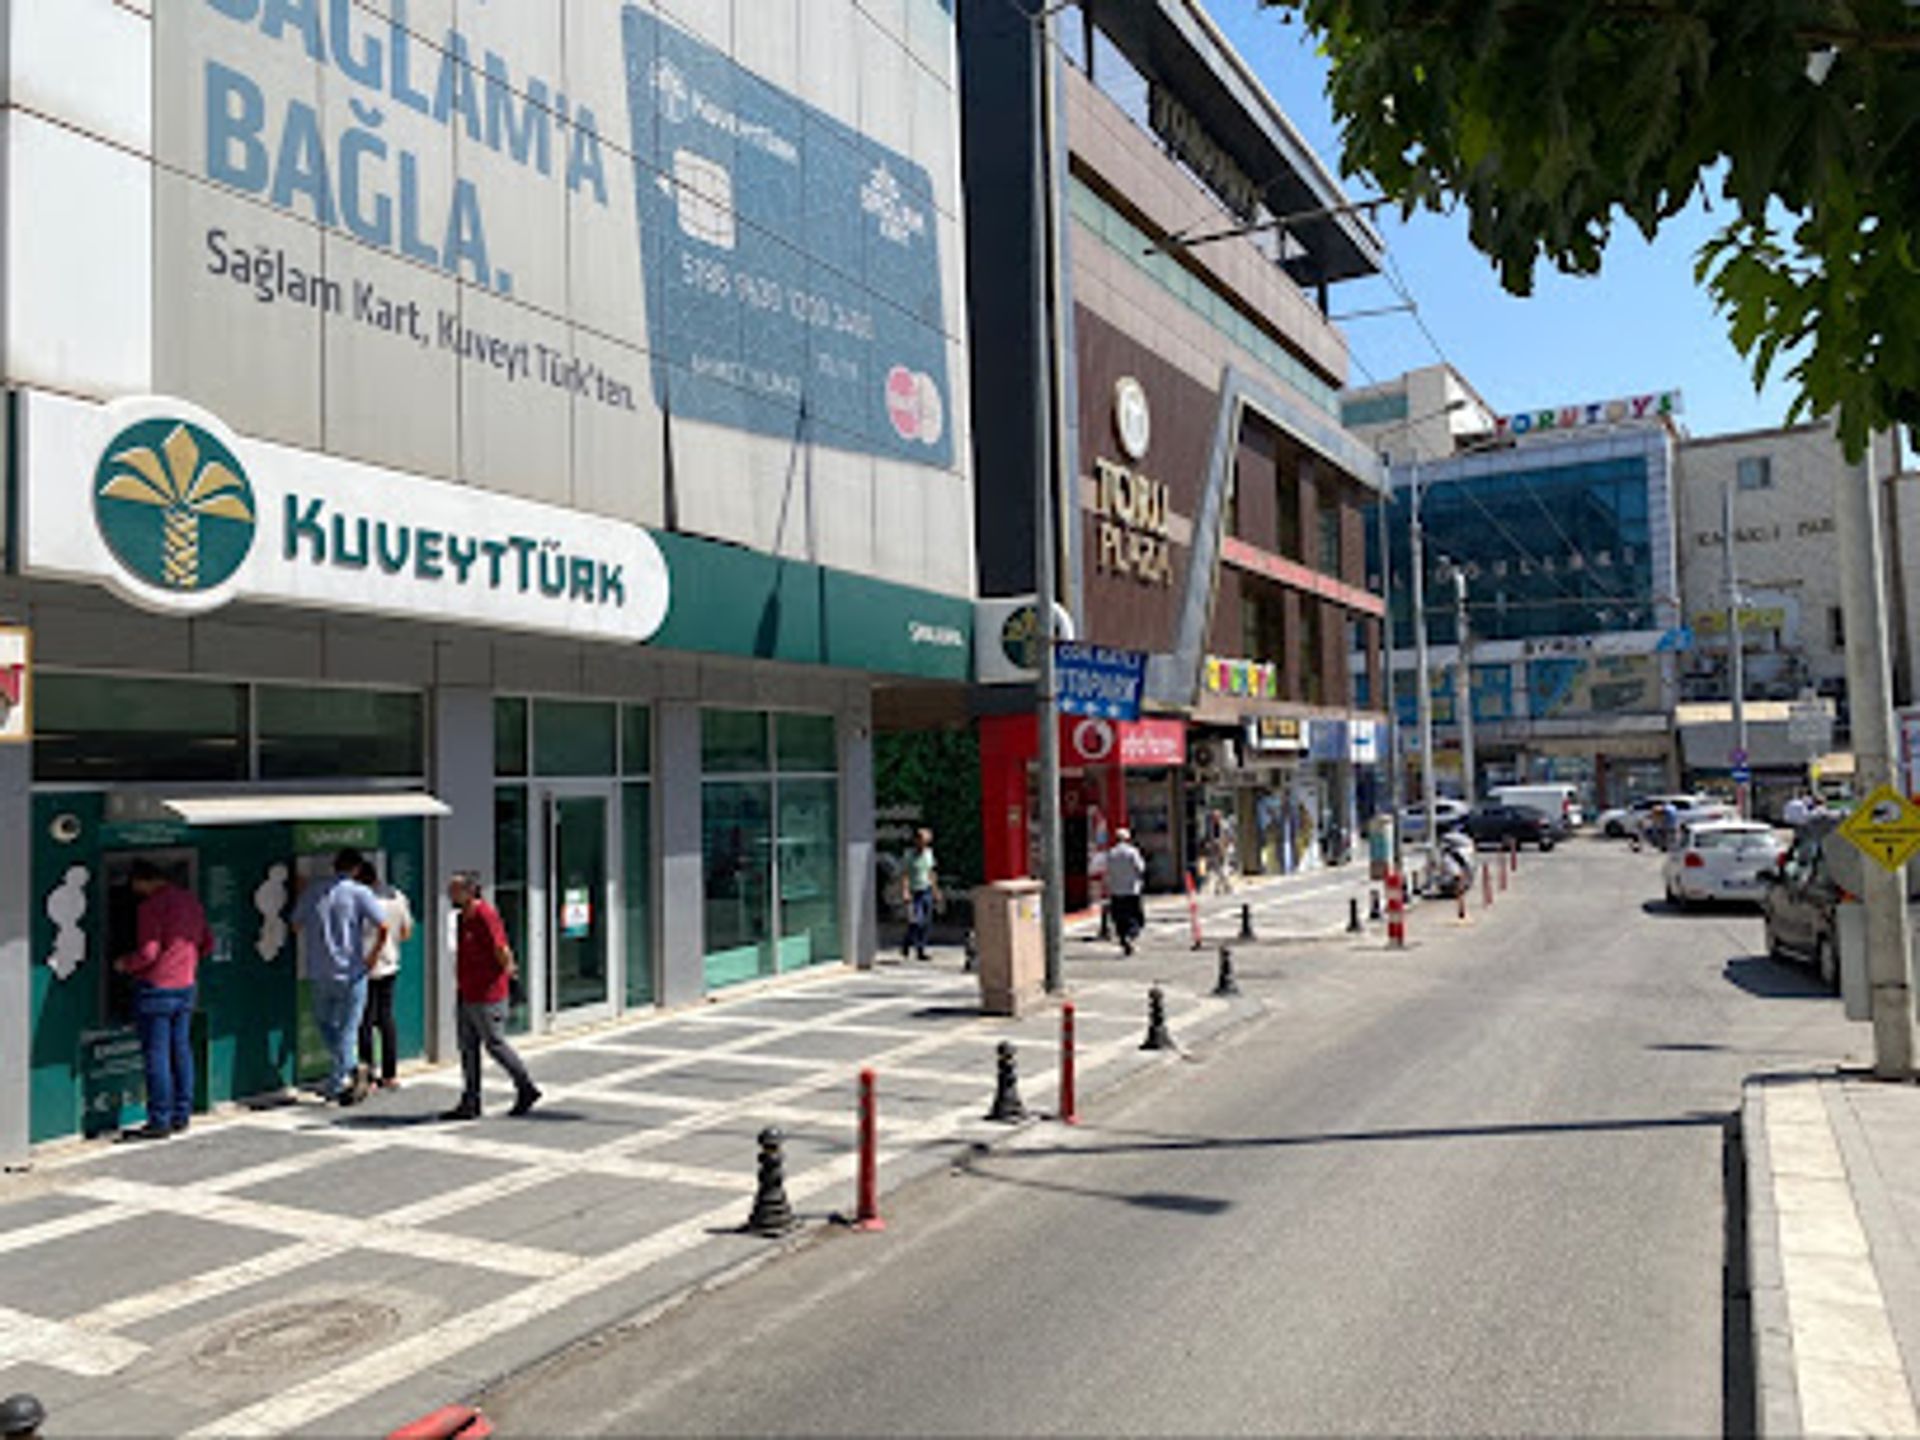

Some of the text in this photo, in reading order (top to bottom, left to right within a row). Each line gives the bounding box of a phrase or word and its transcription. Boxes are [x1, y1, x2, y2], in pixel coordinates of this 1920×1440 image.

[205, 60, 513, 295] BAĞLA.
[206, 229, 341, 314] Sağlam
[353, 278, 429, 348] Kart,
[437, 310, 529, 382] Kuveyt
